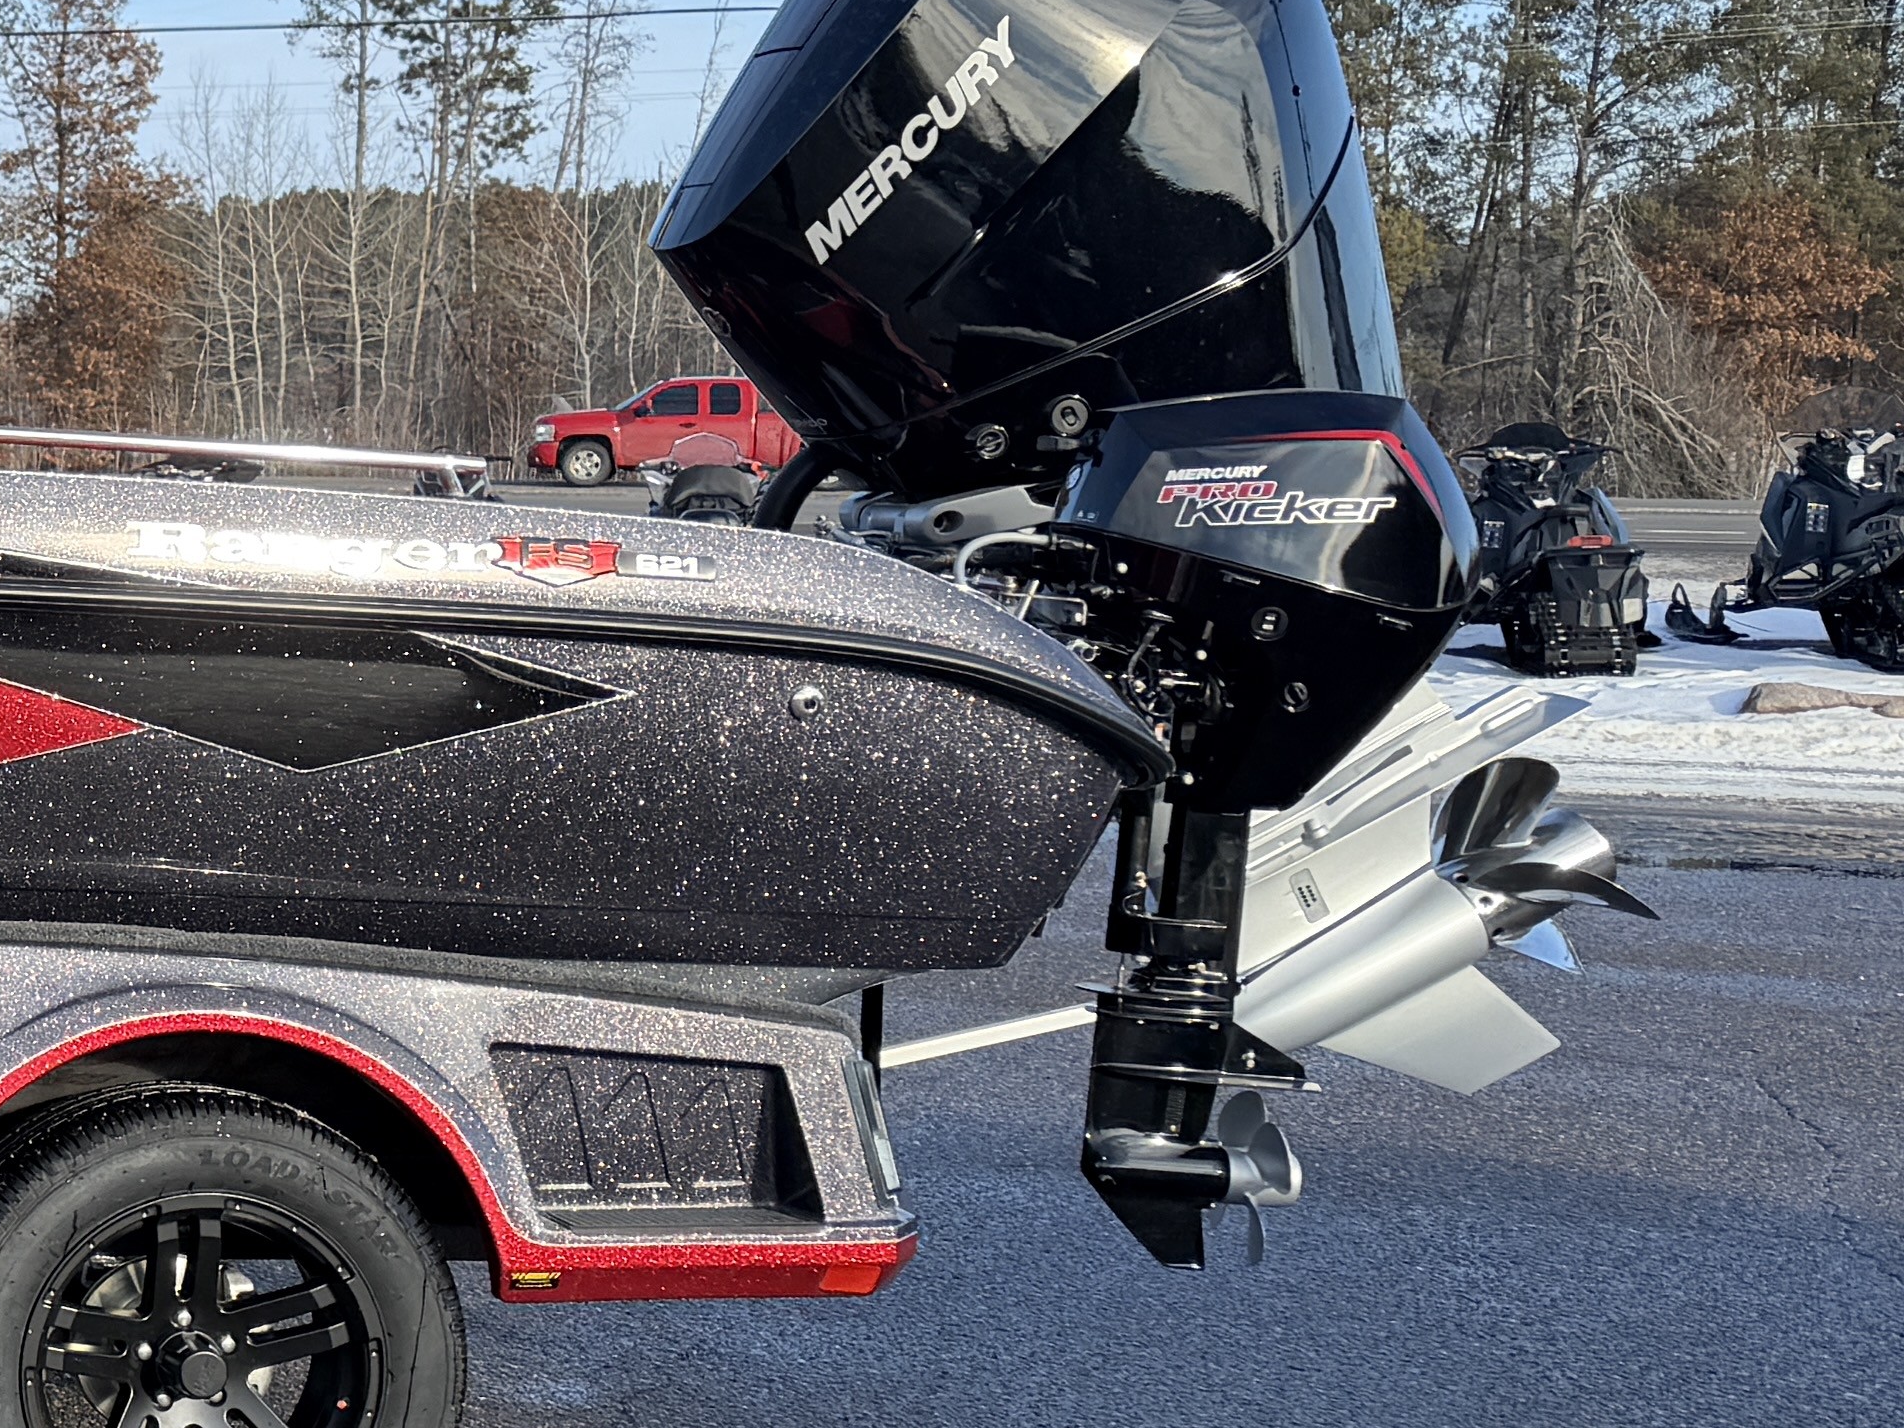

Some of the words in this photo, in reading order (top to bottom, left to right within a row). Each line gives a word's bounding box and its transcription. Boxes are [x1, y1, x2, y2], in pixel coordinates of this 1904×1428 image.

[804, 15, 1015, 266] MERCURY
[1164, 464, 1268, 482] MERCURY
[1157, 481, 1278, 504] PRO
[1174, 490, 1397, 528] Kicker
[635, 553, 700, 574] 621
